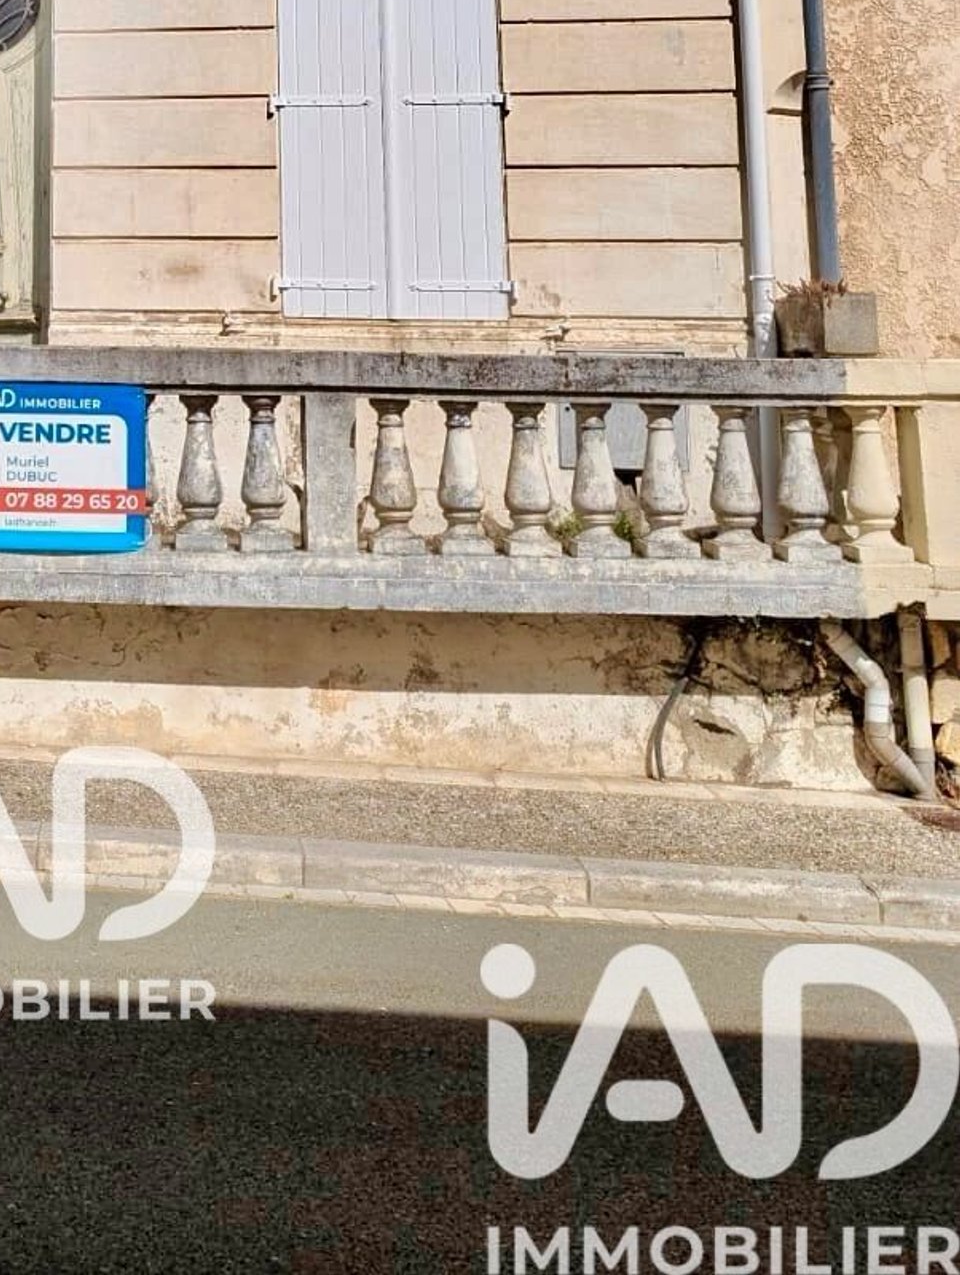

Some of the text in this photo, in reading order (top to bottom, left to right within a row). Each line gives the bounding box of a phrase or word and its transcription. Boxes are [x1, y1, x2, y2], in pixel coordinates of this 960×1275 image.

[20, 397, 102, 409] IMMOBILIER
[6, 455, 49, 468] Muriel
[6, 471, 59, 482] DUBUC
[5, 492, 139, 510] 07 88 29 65 20
